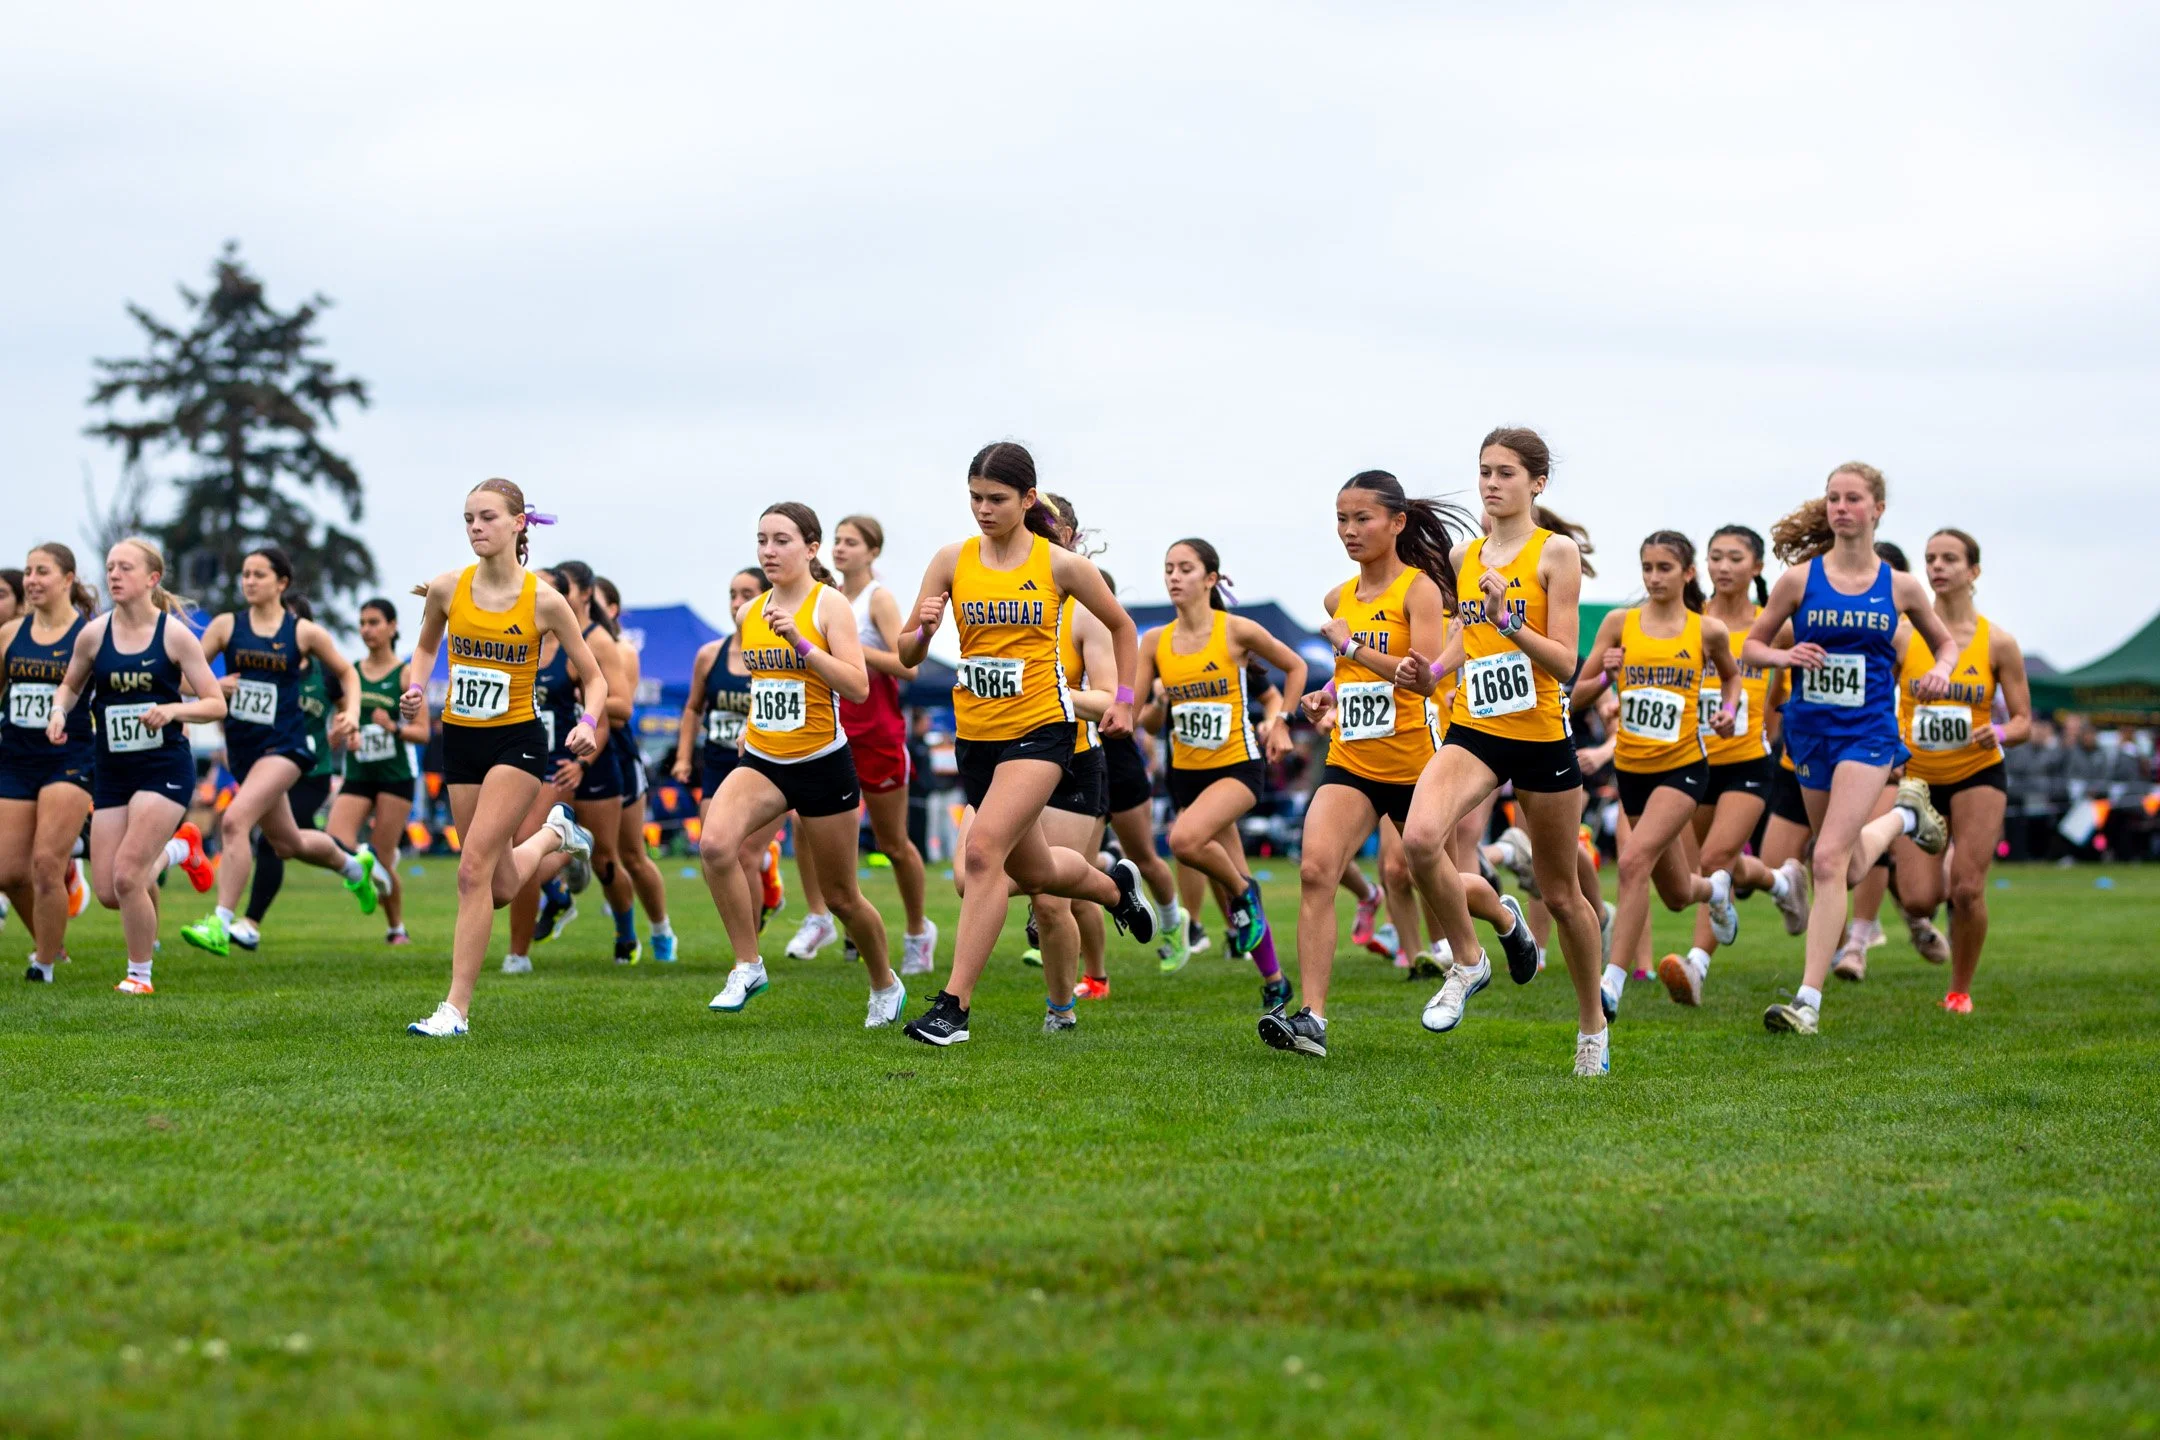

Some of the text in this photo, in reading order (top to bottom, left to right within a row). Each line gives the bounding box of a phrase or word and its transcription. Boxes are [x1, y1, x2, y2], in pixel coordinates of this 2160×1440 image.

[962, 601, 1043, 626] ISSAQUAH
[1807, 609, 1890, 631] PIRATES
[110, 671, 153, 692] AHS
[455, 677, 504, 710] 1677
[964, 664, 1017, 698] 1685
[1471, 663, 1529, 707] 1686
[1808, 667, 1860, 695] 1564
[235, 689, 272, 714] 1732
[755, 690, 801, 721] 1684
[1342, 694, 1391, 729] 1682
[1626, 696, 1678, 731] 1683
[1178, 712, 1223, 741] 1691
[1918, 715, 1968, 742] 1680
